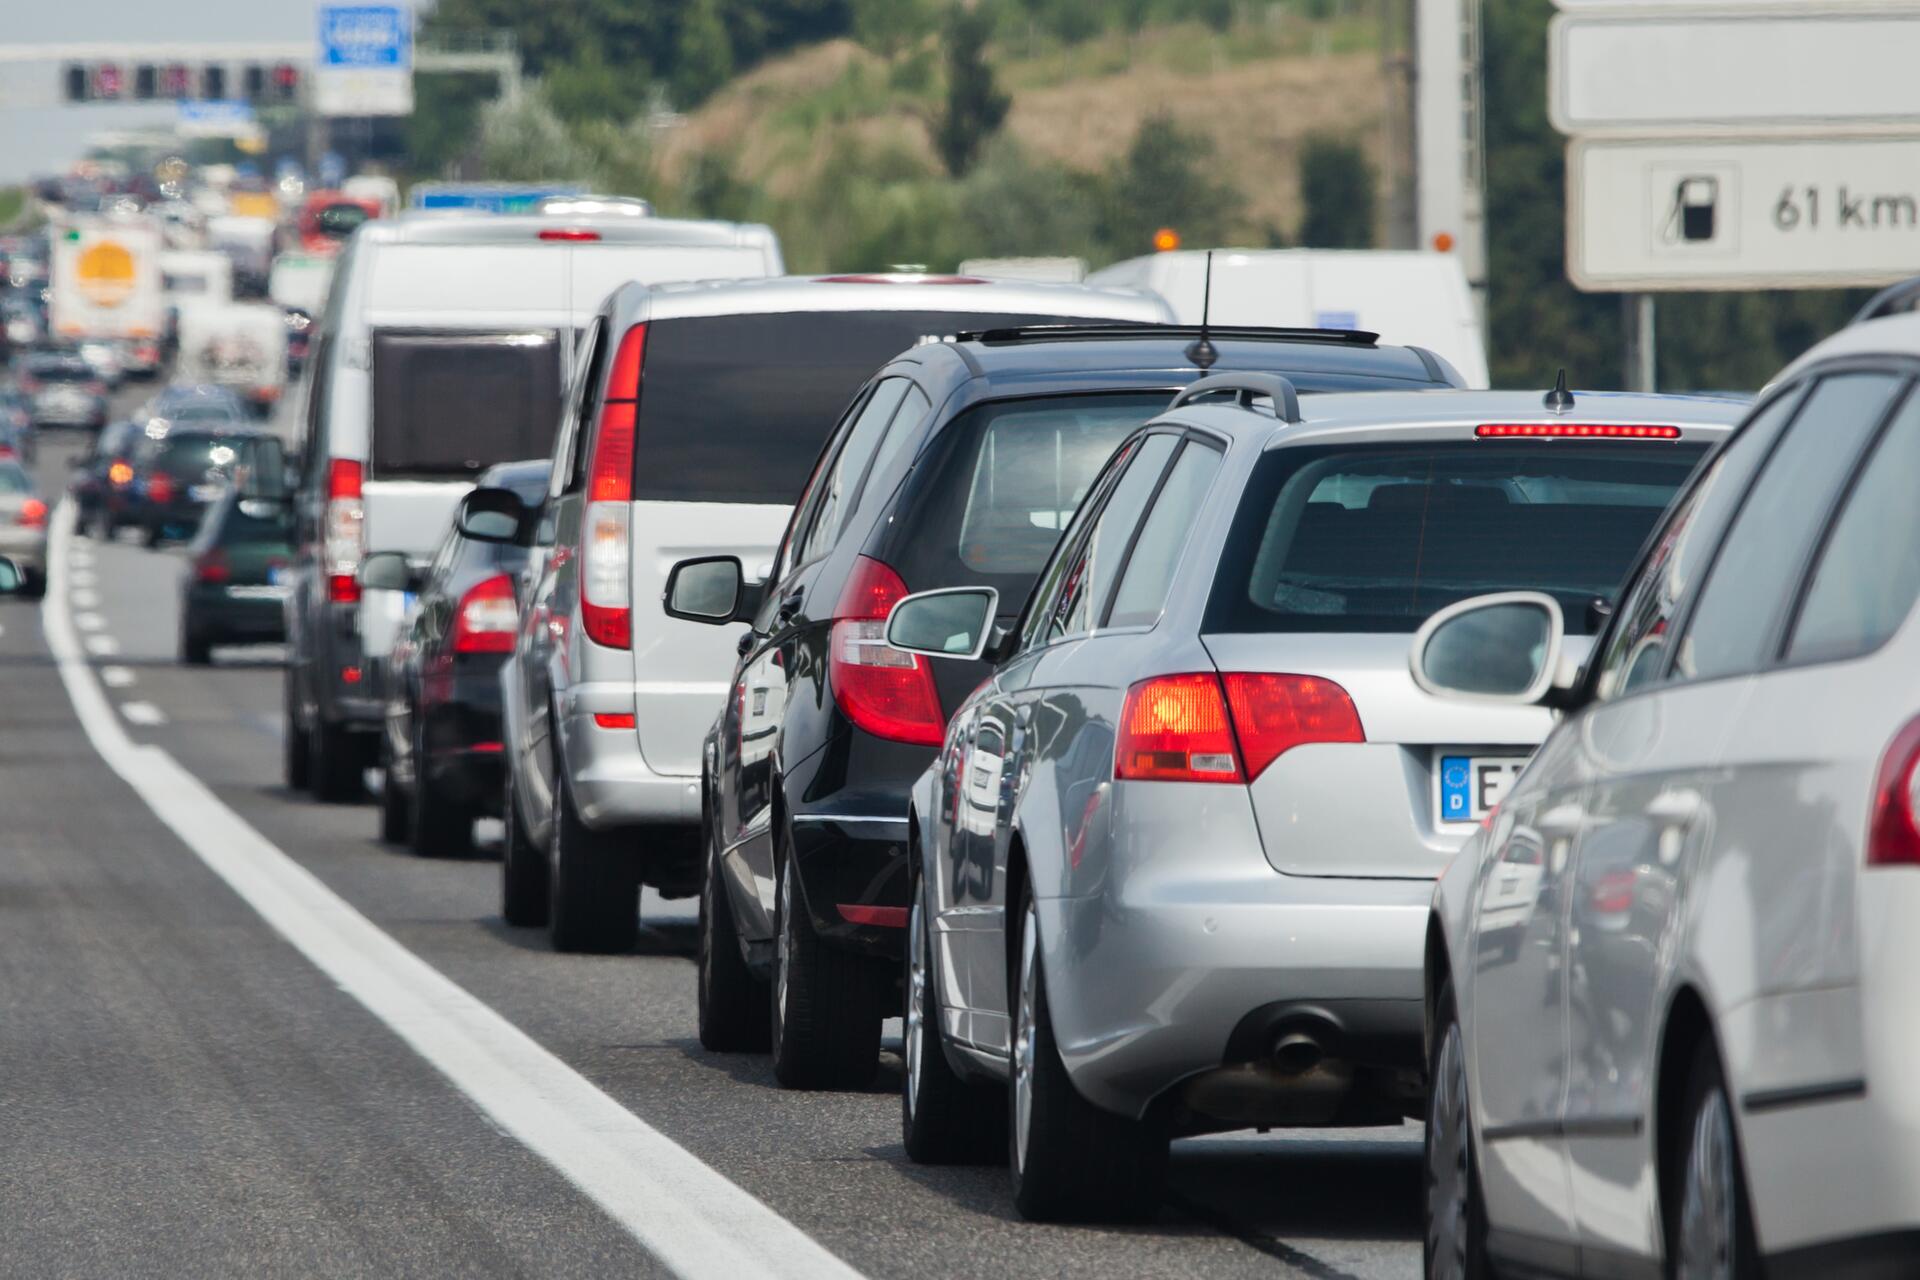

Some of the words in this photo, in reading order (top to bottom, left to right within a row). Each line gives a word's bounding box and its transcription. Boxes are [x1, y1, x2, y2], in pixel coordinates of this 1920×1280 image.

[1773, 185, 1819, 231] 61
[1837, 185, 1918, 230] km
[1450, 793, 1463, 810] D
[1478, 765, 1525, 811] E
